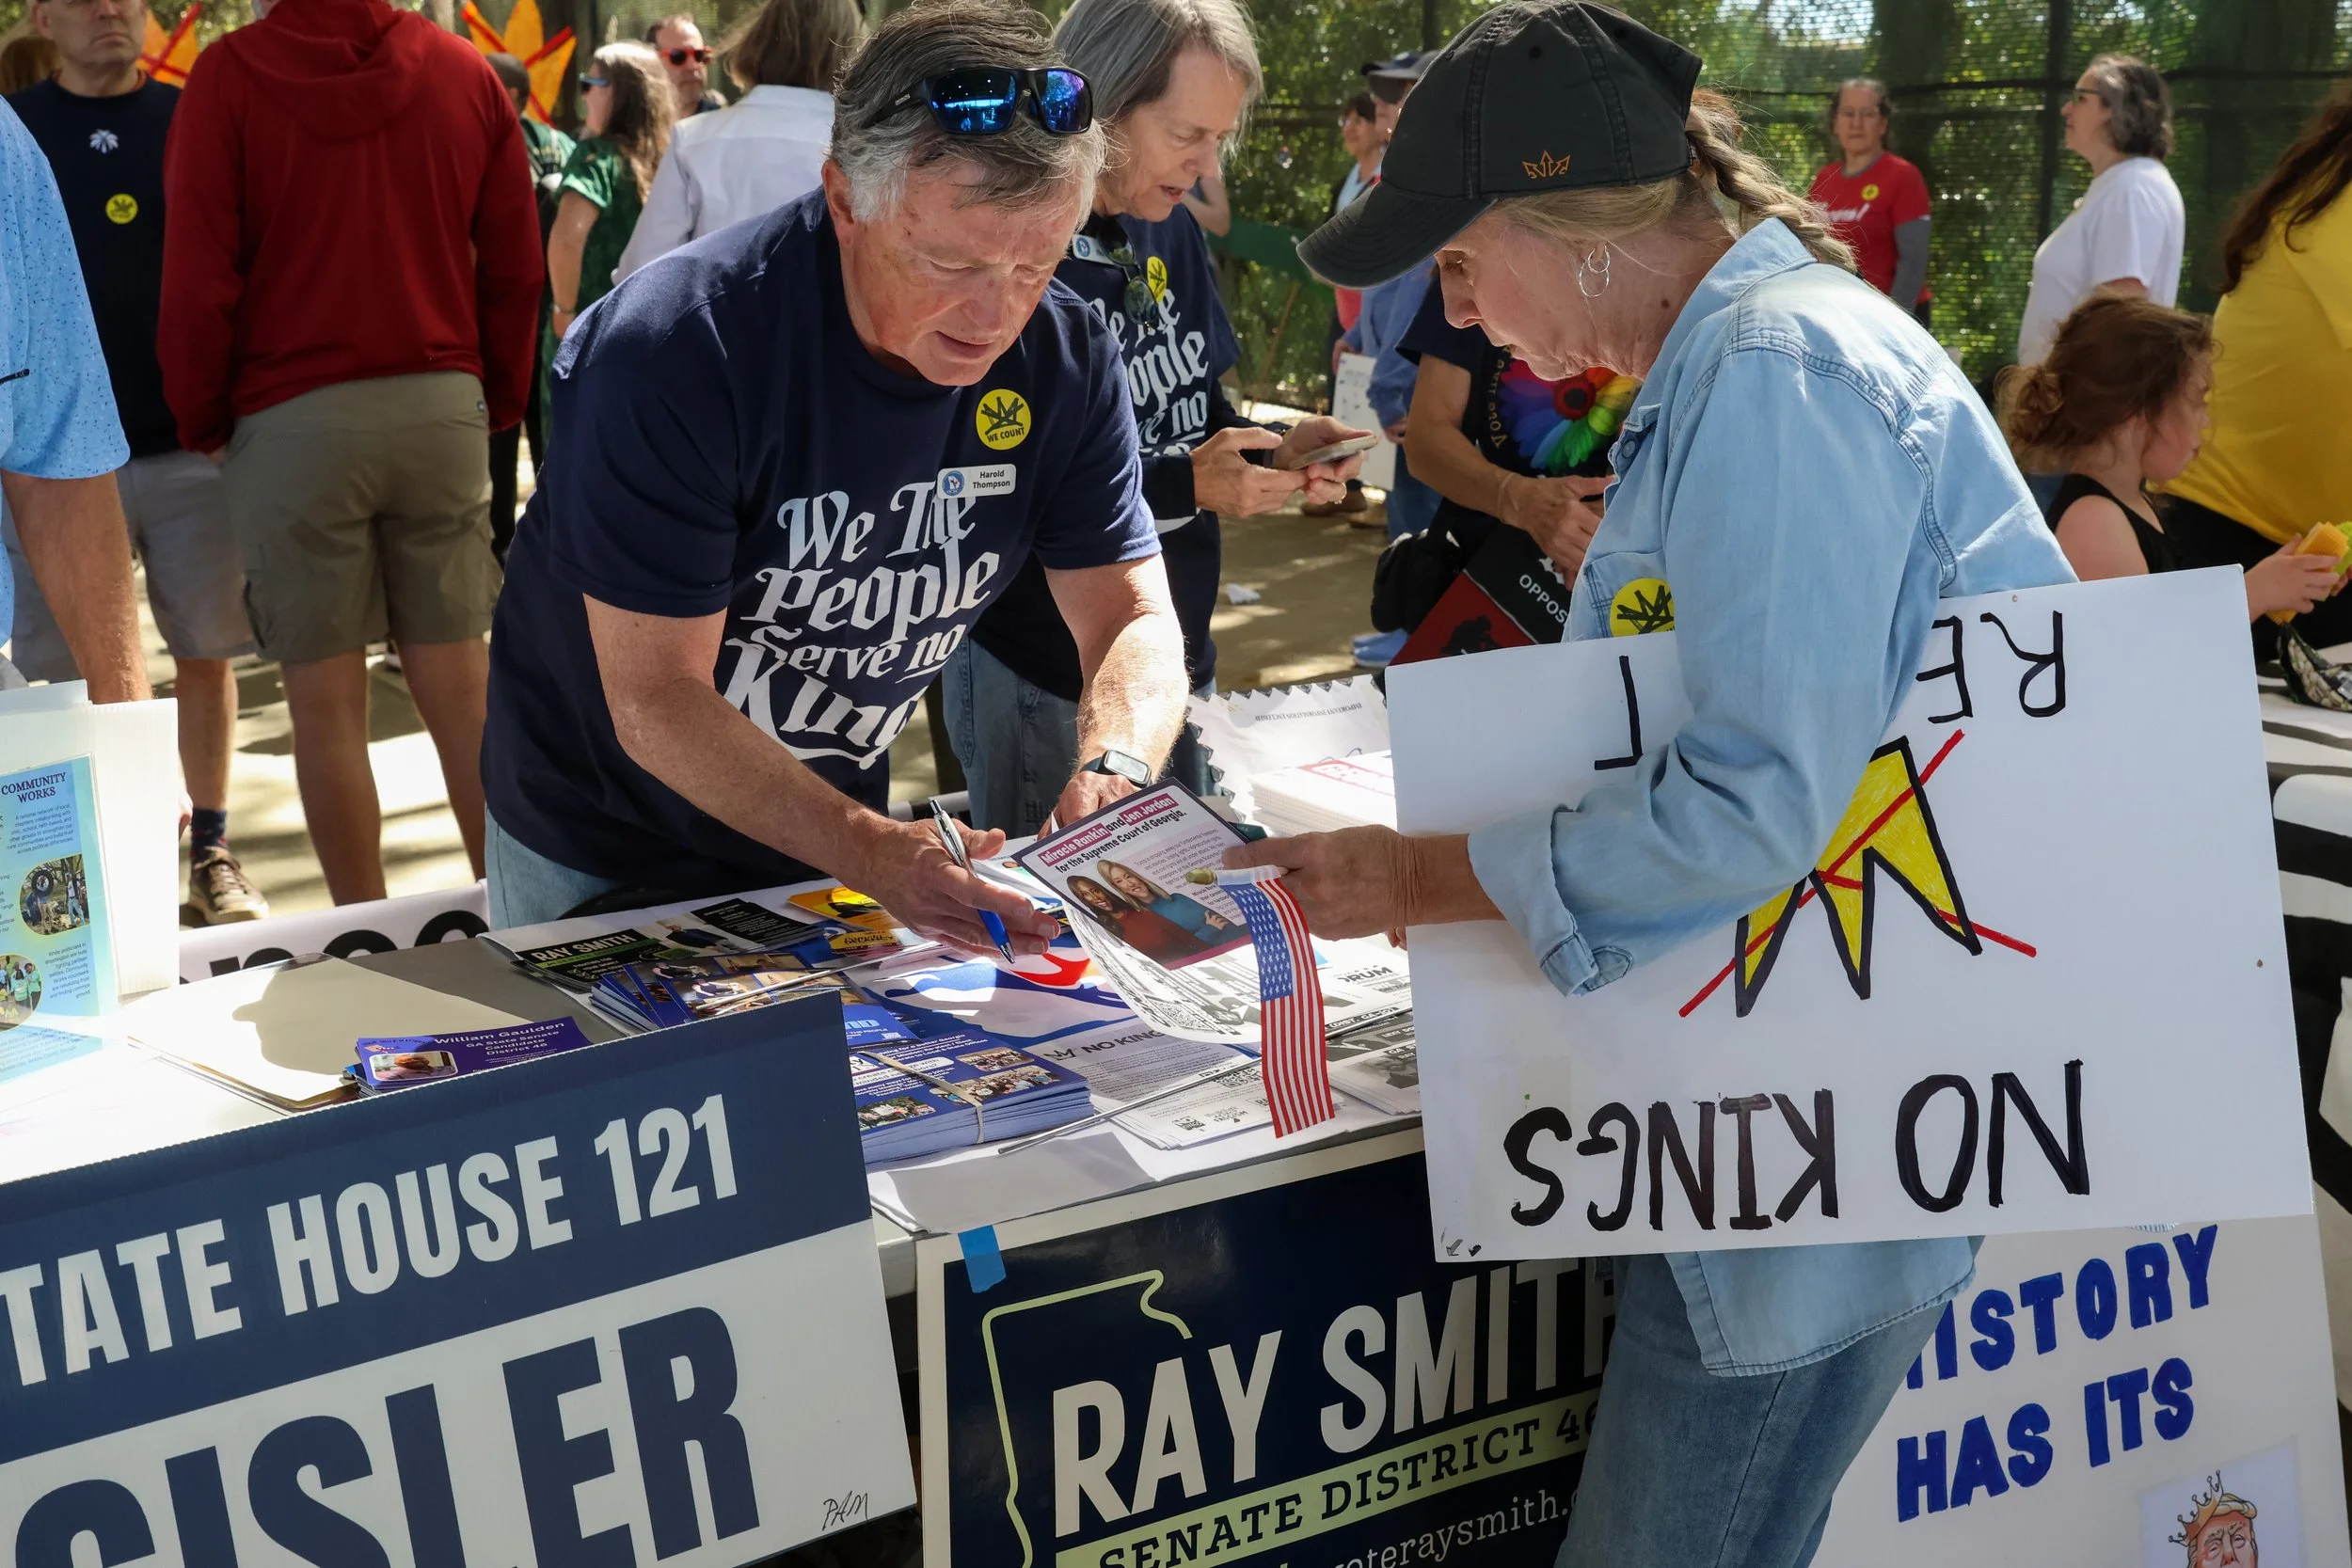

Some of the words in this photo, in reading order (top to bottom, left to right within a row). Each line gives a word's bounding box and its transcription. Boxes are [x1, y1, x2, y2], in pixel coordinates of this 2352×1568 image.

[1124, 331, 1209, 417] ople
[987, 433, 998, 443] WE
[1000, 427, 1025, 439] COUNT
[1171, 390, 1208, 436] no
[973, 480, 1010, 489] Thompson
[979, 469, 1005, 479] Harold
[777, 490, 875, 569] We
[885, 481, 976, 559] The
[739, 540, 999, 644] People
[1518, 573, 1570, 626] OPPOS
[751, 625, 901, 679] Serve
[905, 624, 967, 673] no
[723, 637, 930, 769] Kin
[2, 772, 66, 795] COMMUNITY
[18, 786, 56, 803] WORKS
[1041, 844, 1075, 864] Miracle
[1074, 826, 1107, 850] Rankin
[1106, 816, 1125, 832] and
[1124, 811, 1142, 824] Jen
[1141, 798, 1174, 821] Jordan
[1056, 863, 1070, 873] for
[1070, 855, 1084, 867] the
[1081, 838, 1120, 863] Supreme
[1117, 827, 1145, 845] Court
[1142, 821, 1152, 832] of
[1152, 811, 1187, 829] Georgia.
[531, 946, 573, 961] RAY
[573, 934, 638, 953] SMITH
[1336, 965, 1393, 983] RUM
[434, 1033, 495, 1045] William
[498, 1022, 564, 1037] Gaulden
[485, 1038, 545, 1051] Candidate
[486, 1037, 516, 1046] State
[519, 1031, 559, 1042] Senate
[486, 1046, 529, 1055] District
[1081, 1040, 1113, 1054] NO
[1119, 1029, 1168, 1046] KING
[1503, 1088, 1838, 1231] KINGS
[1895, 1059, 2090, 1213] NO
[0, 1218, 242, 1386] TATE
[266, 1135, 573, 1317] HOUSE
[594, 1094, 738, 1227] 121
[1053, 1329, 1282, 1539] RAY
[1897, 1402, 2053, 1523] HAS
[2084, 1357, 2194, 1467] ITS
[822, 1490, 868, 1531] PAM
[1098, 1496, 1303, 1568] SENATE
[1321, 1422, 1541, 1520] DISTRICT
[1334, 1489, 1578, 1568] teraysmith.
